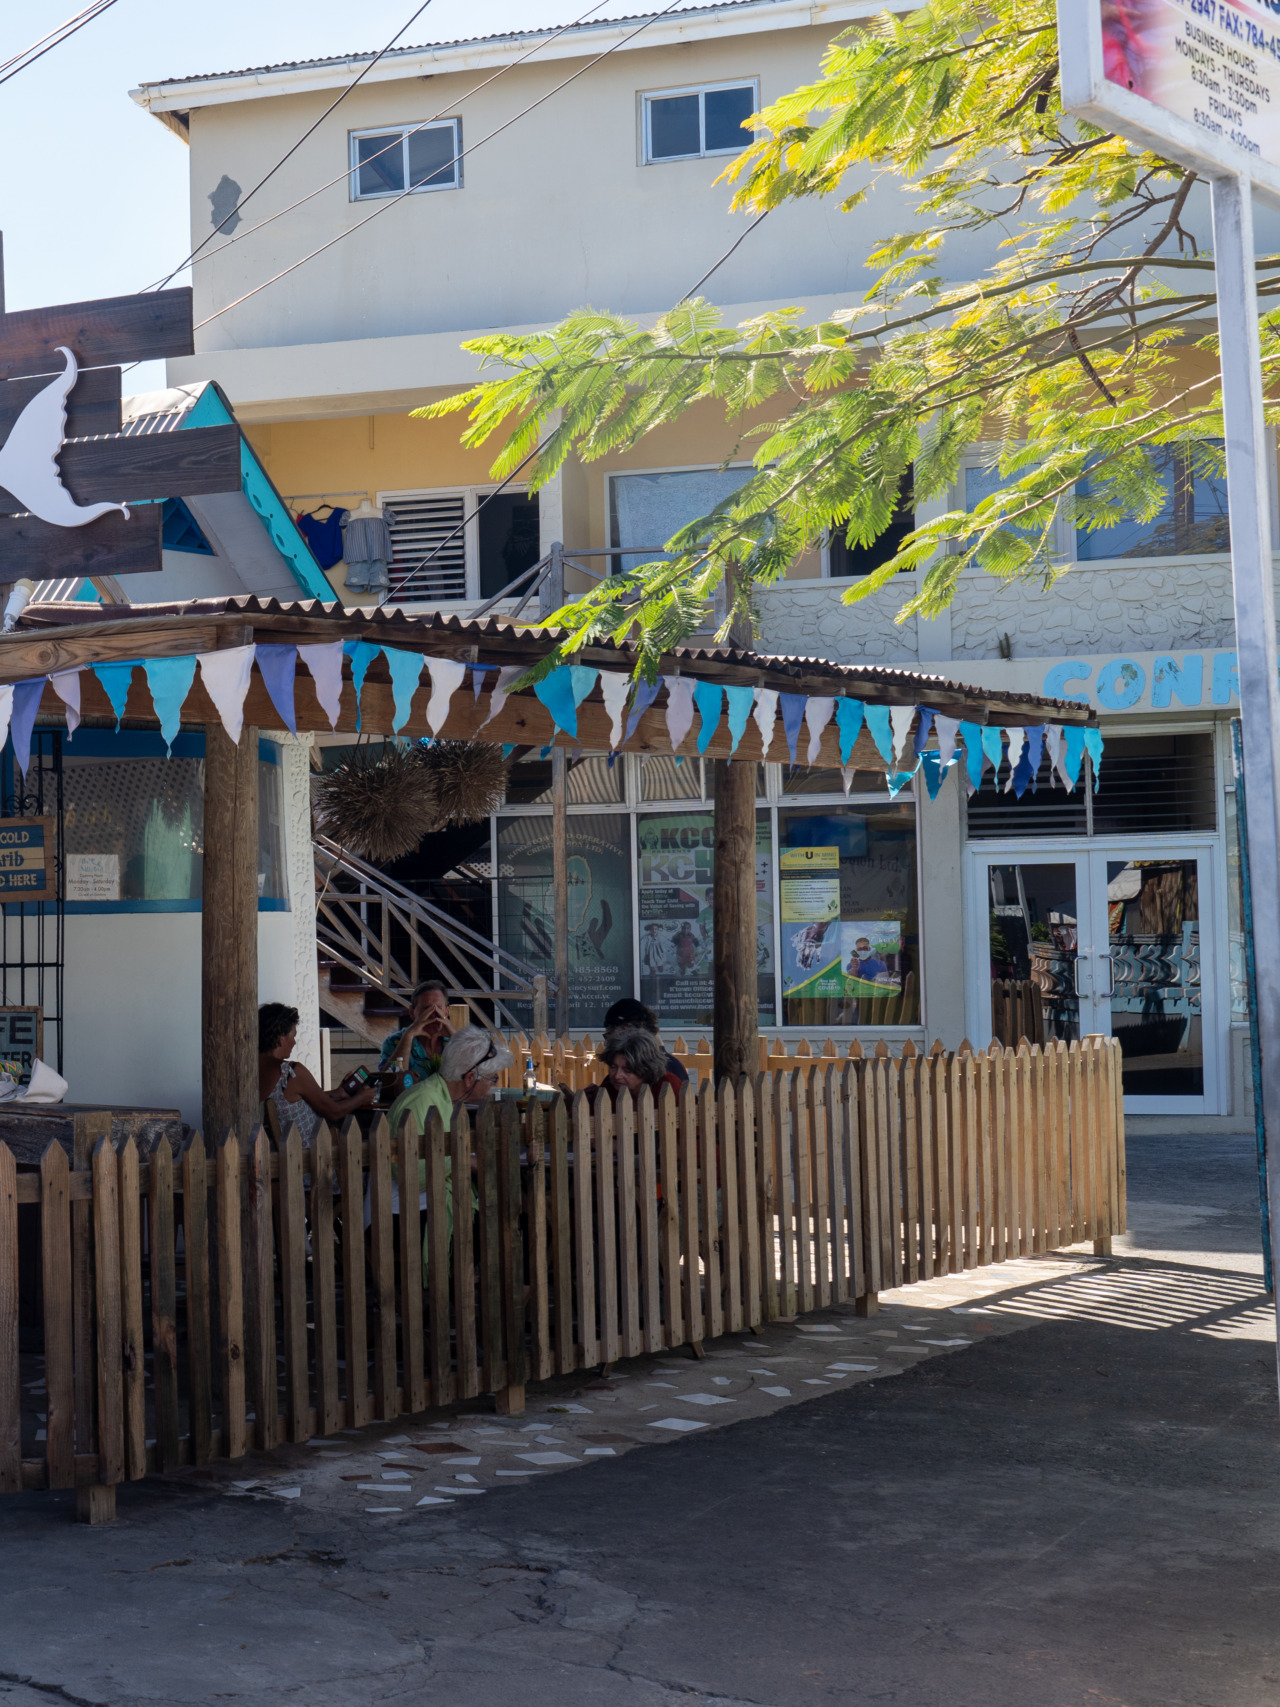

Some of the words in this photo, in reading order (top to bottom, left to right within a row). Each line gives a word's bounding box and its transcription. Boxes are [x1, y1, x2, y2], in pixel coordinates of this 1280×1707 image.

[1219, 4, 1244, 42] FAX:
[1185, 20, 1225, 57] BUSINESS
[1227, 45, 1259, 77] HOURS:
[1175, 36, 1216, 73] MONDAYS
[1223, 65, 1271, 103] THURSDAYS
[1191, 66, 1221, 96] 8:30am
[1228, 86, 1258, 115] 3:30pm
[1209, 96, 1243, 127] FRIDAYS
[1194, 108, 1223, 136] 8:30am
[1230, 131, 1261, 156] 4:00pm
[0, 831, 29, 844] COLD
[567, 833, 624, 857] O-OPERATIVE
[660, 827, 714, 849] KCC
[805, 851, 814, 860] U
[9, 873, 37, 887] HERE
